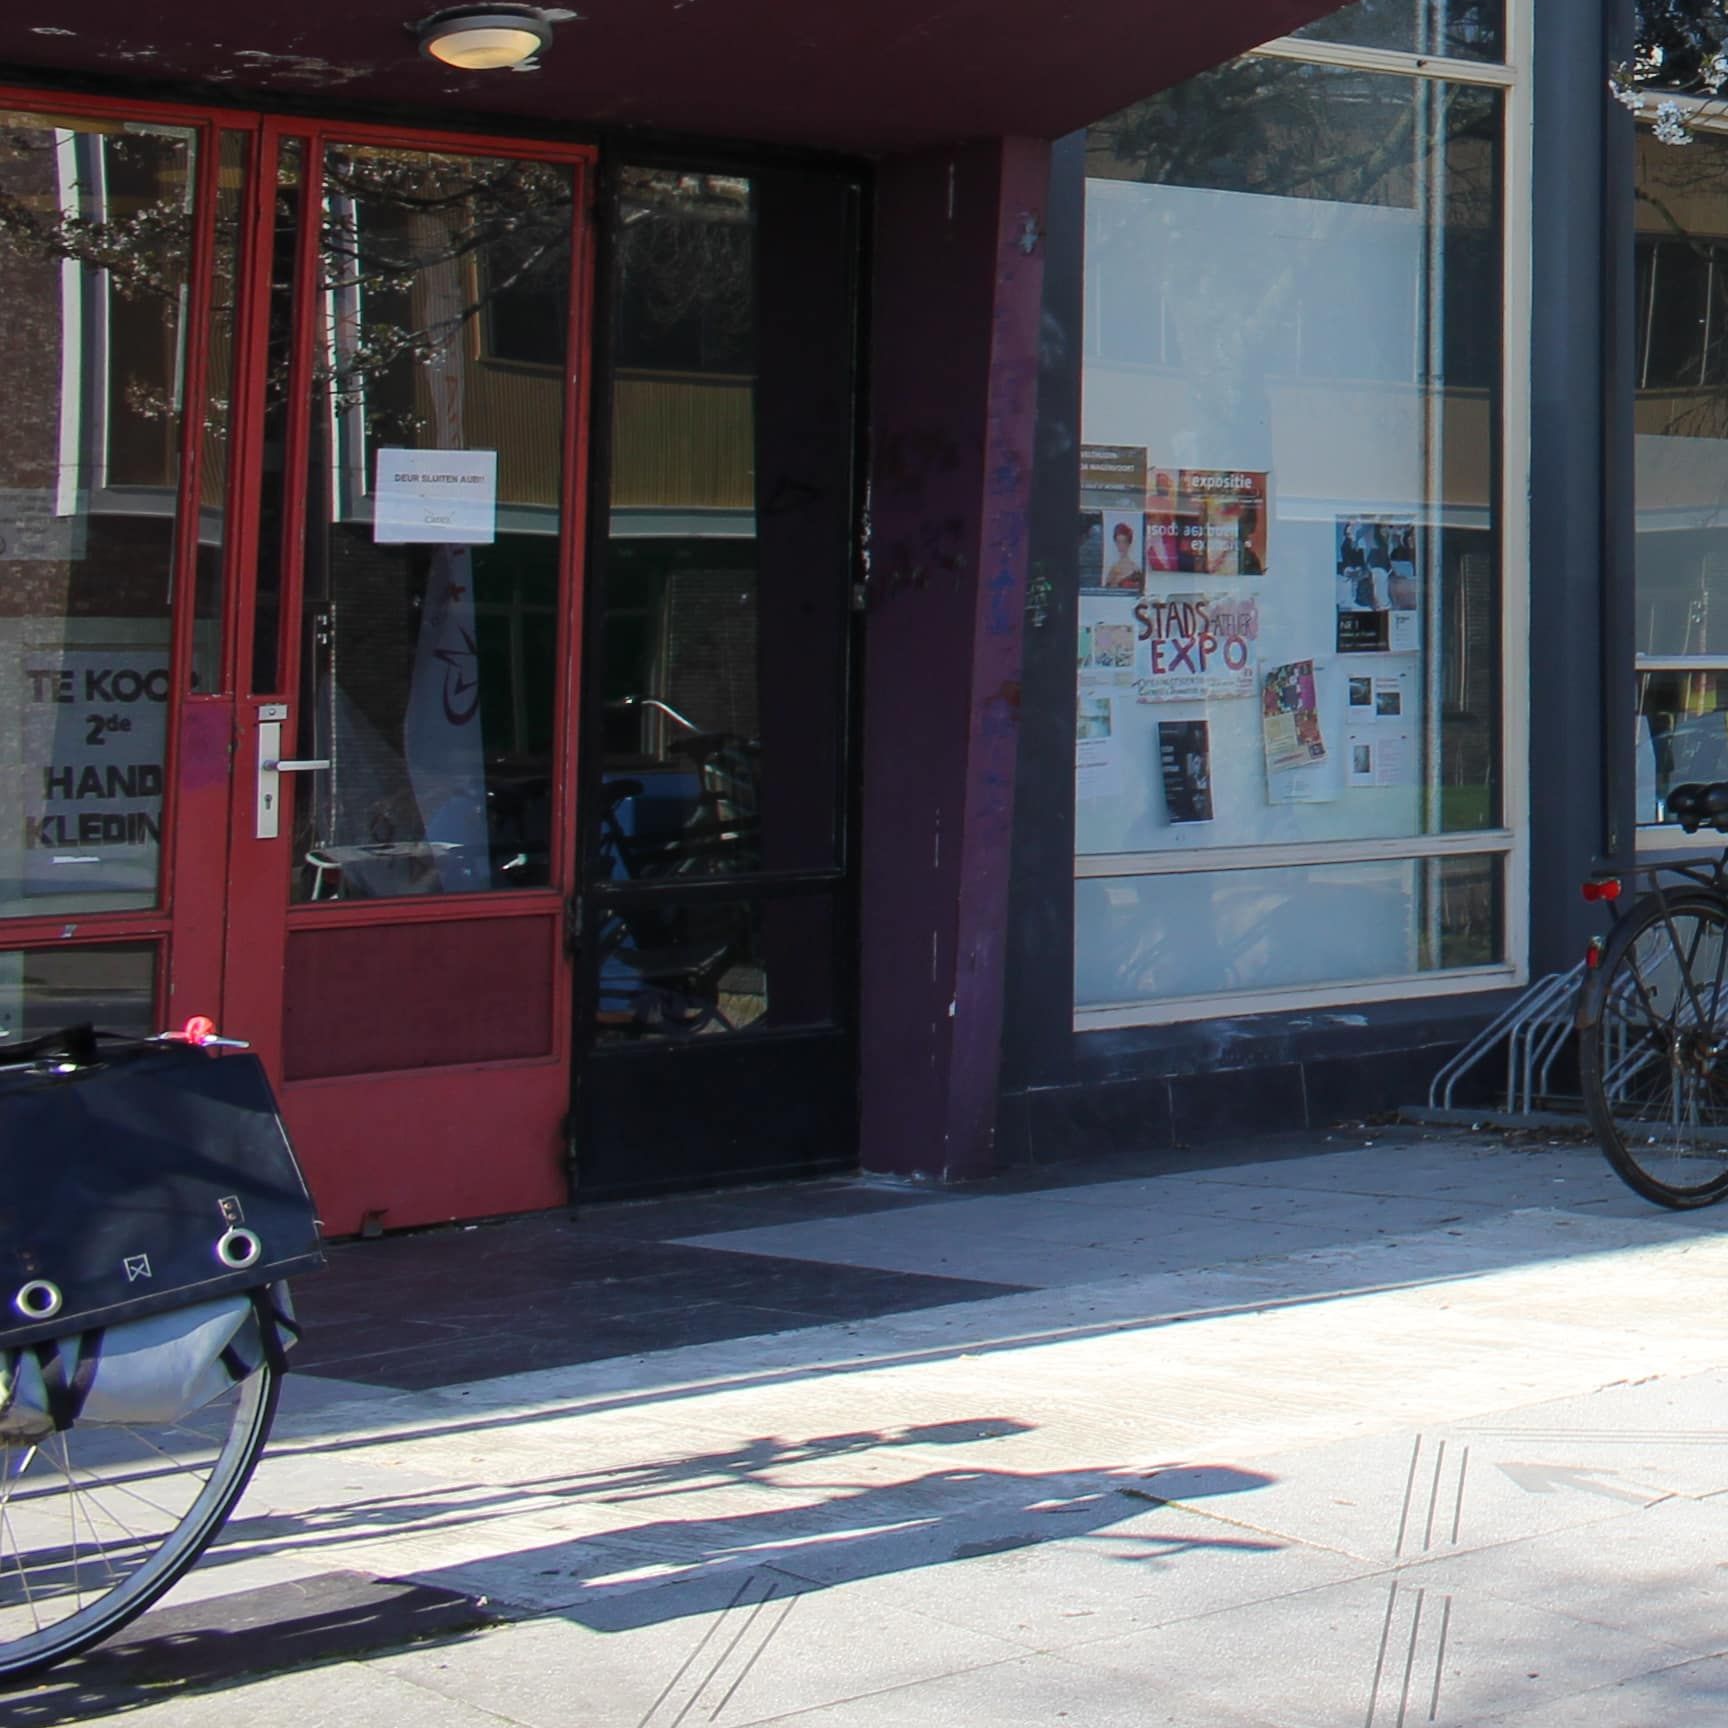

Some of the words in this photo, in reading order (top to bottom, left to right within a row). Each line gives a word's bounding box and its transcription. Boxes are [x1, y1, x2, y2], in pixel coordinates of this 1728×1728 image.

[394, 473, 419, 482] DEUR
[421, 474, 457, 483] SLUITEN
[1191, 474, 1253, 489] expositie
[1151, 632, 1248, 674] EXPO
[26, 669, 75, 704] TE
[86, 668, 199, 703] KOO
[84, 713, 132, 746] 2de
[45, 765, 163, 800] HAND
[25, 812, 163, 849] KLEDIN
